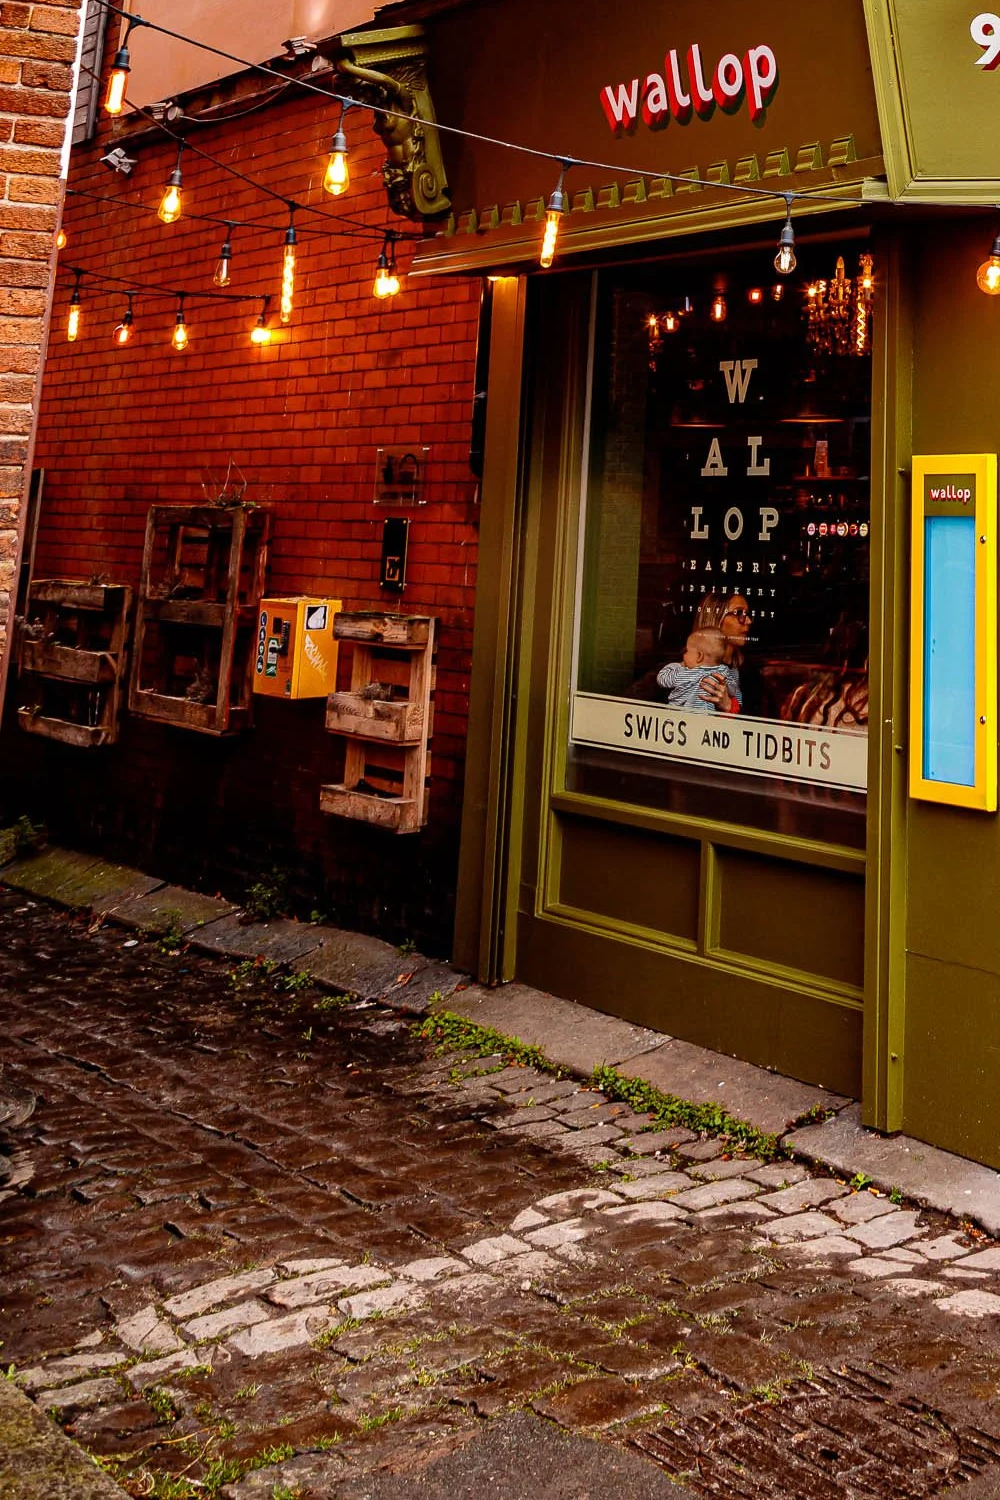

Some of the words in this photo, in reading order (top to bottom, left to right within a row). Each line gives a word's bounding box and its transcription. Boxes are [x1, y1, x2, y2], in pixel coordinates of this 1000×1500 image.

[601, 44, 777, 130] wallop
[719, 359, 758, 404] W
[929, 485, 971, 504] wallop
[624, 713, 687, 746] SWIGS
[701, 730, 730, 749] AND
[743, 731, 831, 770] TIDBITS
